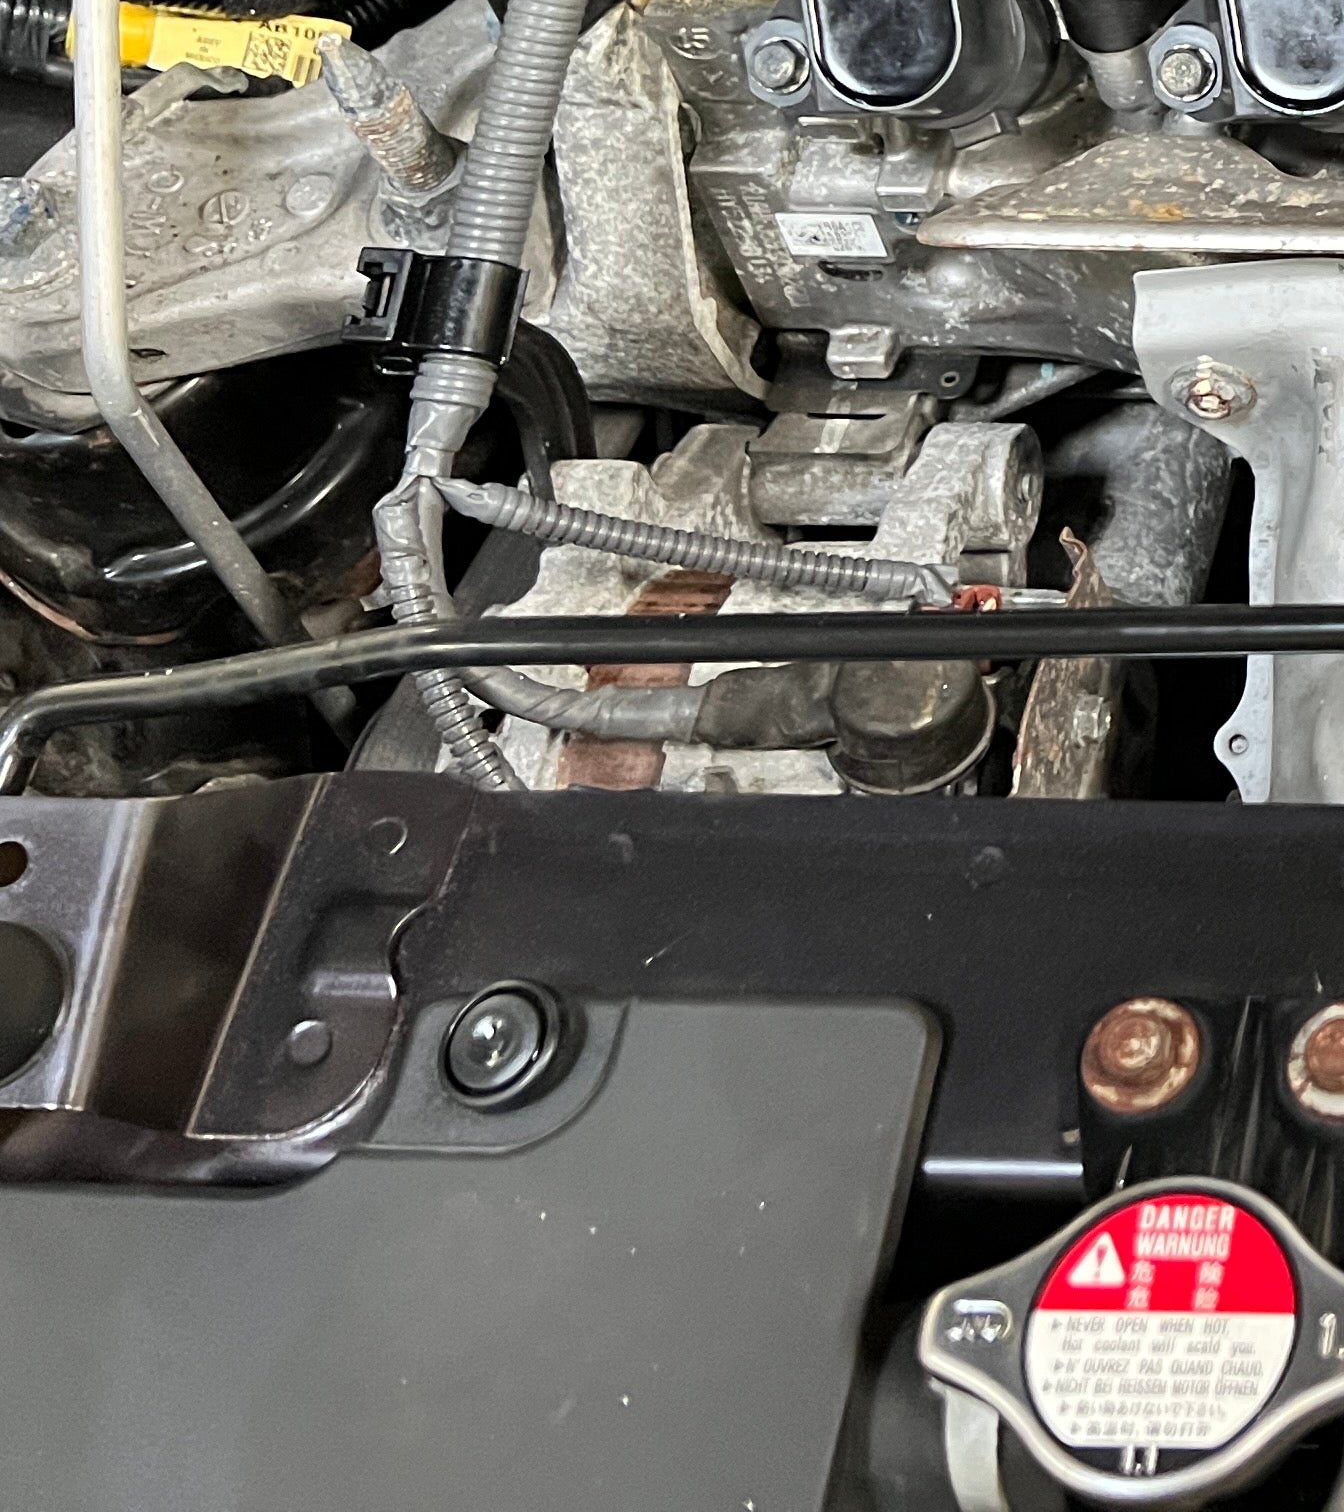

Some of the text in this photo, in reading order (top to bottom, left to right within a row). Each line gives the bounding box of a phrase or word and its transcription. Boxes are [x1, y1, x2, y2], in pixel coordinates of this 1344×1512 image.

[1140, 1204, 1236, 1230] DANGER
[1135, 1231, 1230, 1257] WARNUNG
[1066, 1317, 1106, 1334] NEVER
[1115, 1318, 1149, 1334] OPEN
[1159, 1318, 1195, 1334] WHEN
[1062, 1336, 1256, 1357] Hot coolant will scald you.
[1083, 1359, 1131, 1374] OUVREZ
[1138, 1359, 1163, 1375] PAS
[1170, 1360, 1214, 1376] QUAND
[1055, 1378, 1090, 1394] NICHT
[1093, 1379, 1113, 1394] BEI
[1118, 1379, 1167, 1395] HEISSEN
[1172, 1380, 1211, 1395] MOTOR
